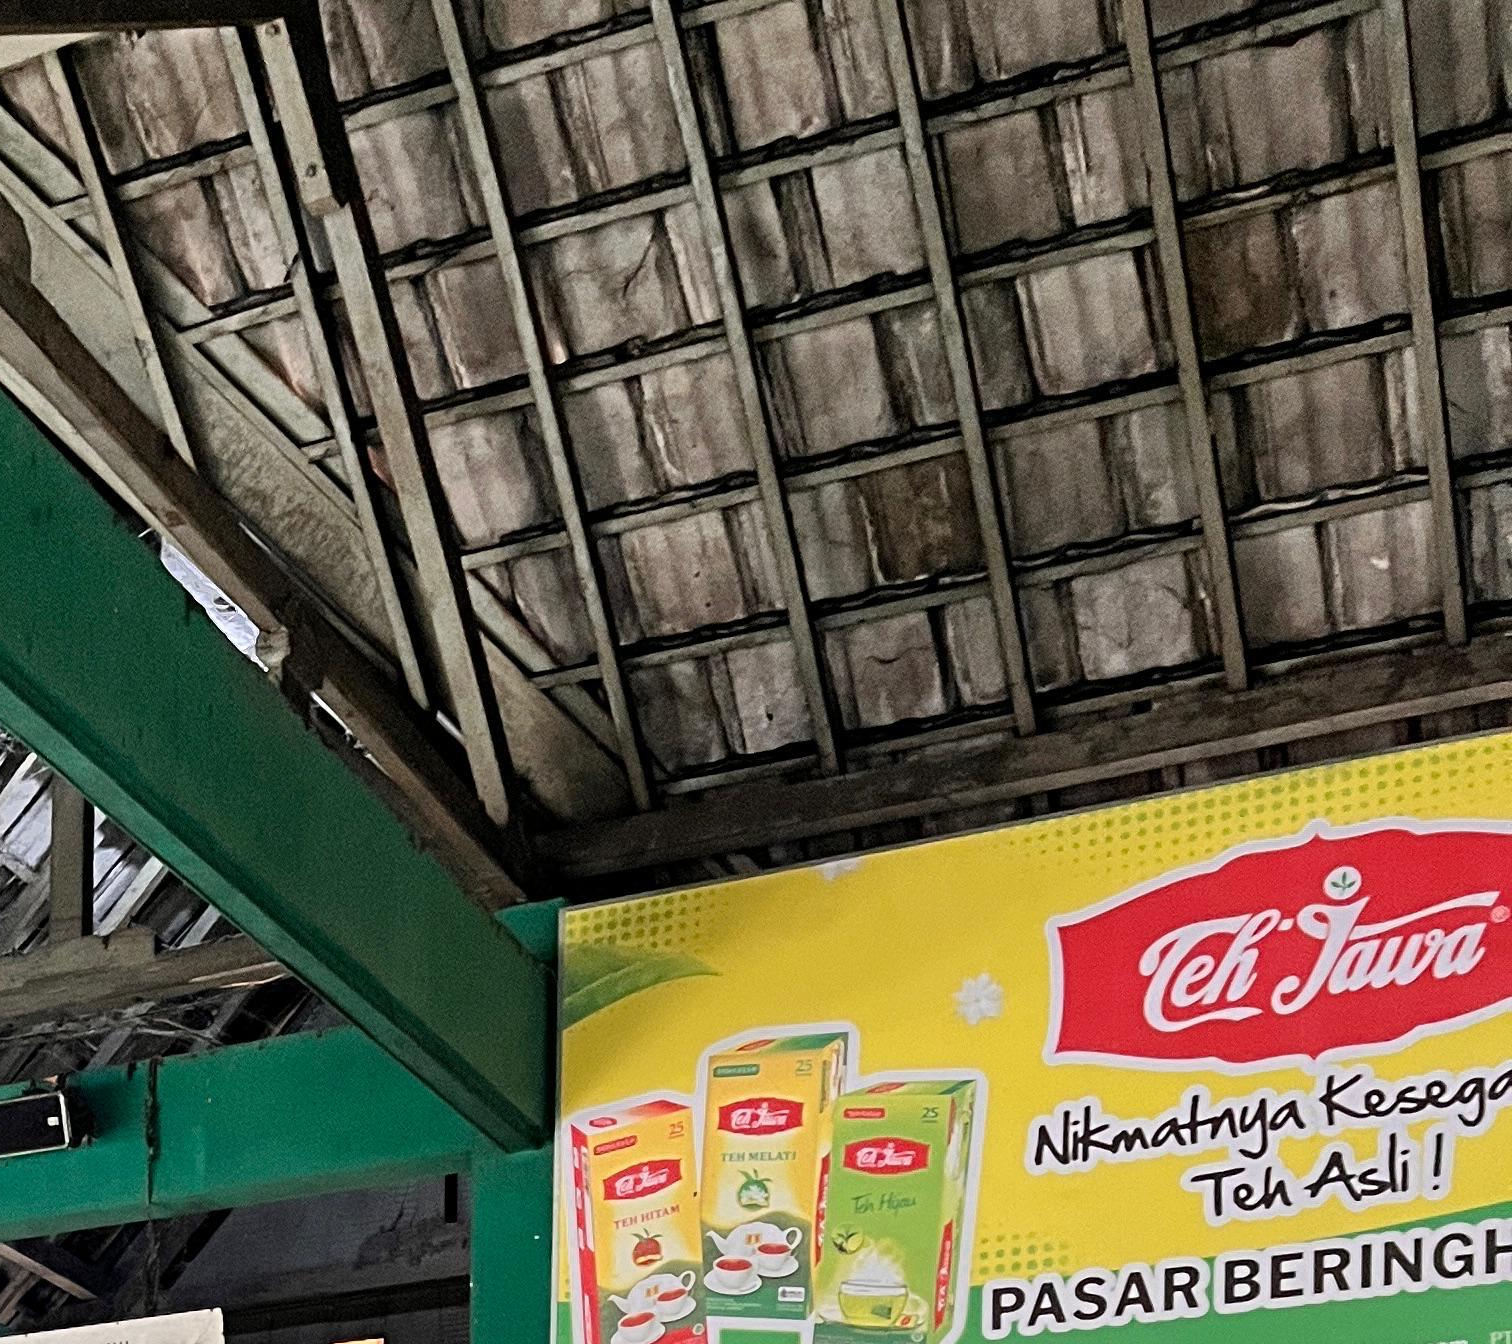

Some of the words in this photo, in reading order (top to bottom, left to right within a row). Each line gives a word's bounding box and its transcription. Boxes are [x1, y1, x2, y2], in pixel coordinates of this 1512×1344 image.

[1139, 908, 1279, 1033] Teh
[1271, 890, 1500, 1016] Jawa
[721, 1152, 745, 1162] TEH
[748, 1150, 796, 1161] MELATI
[1034, 1095, 1304, 1166] Nikmatnya
[614, 1217, 638, 1229] TEH
[641, 1205, 680, 1225] HITAM
[1190, 1168, 1292, 1216] Teh
[991, 1266, 1200, 1330] PASAR
[1225, 1228, 1512, 1305] BERINGH
